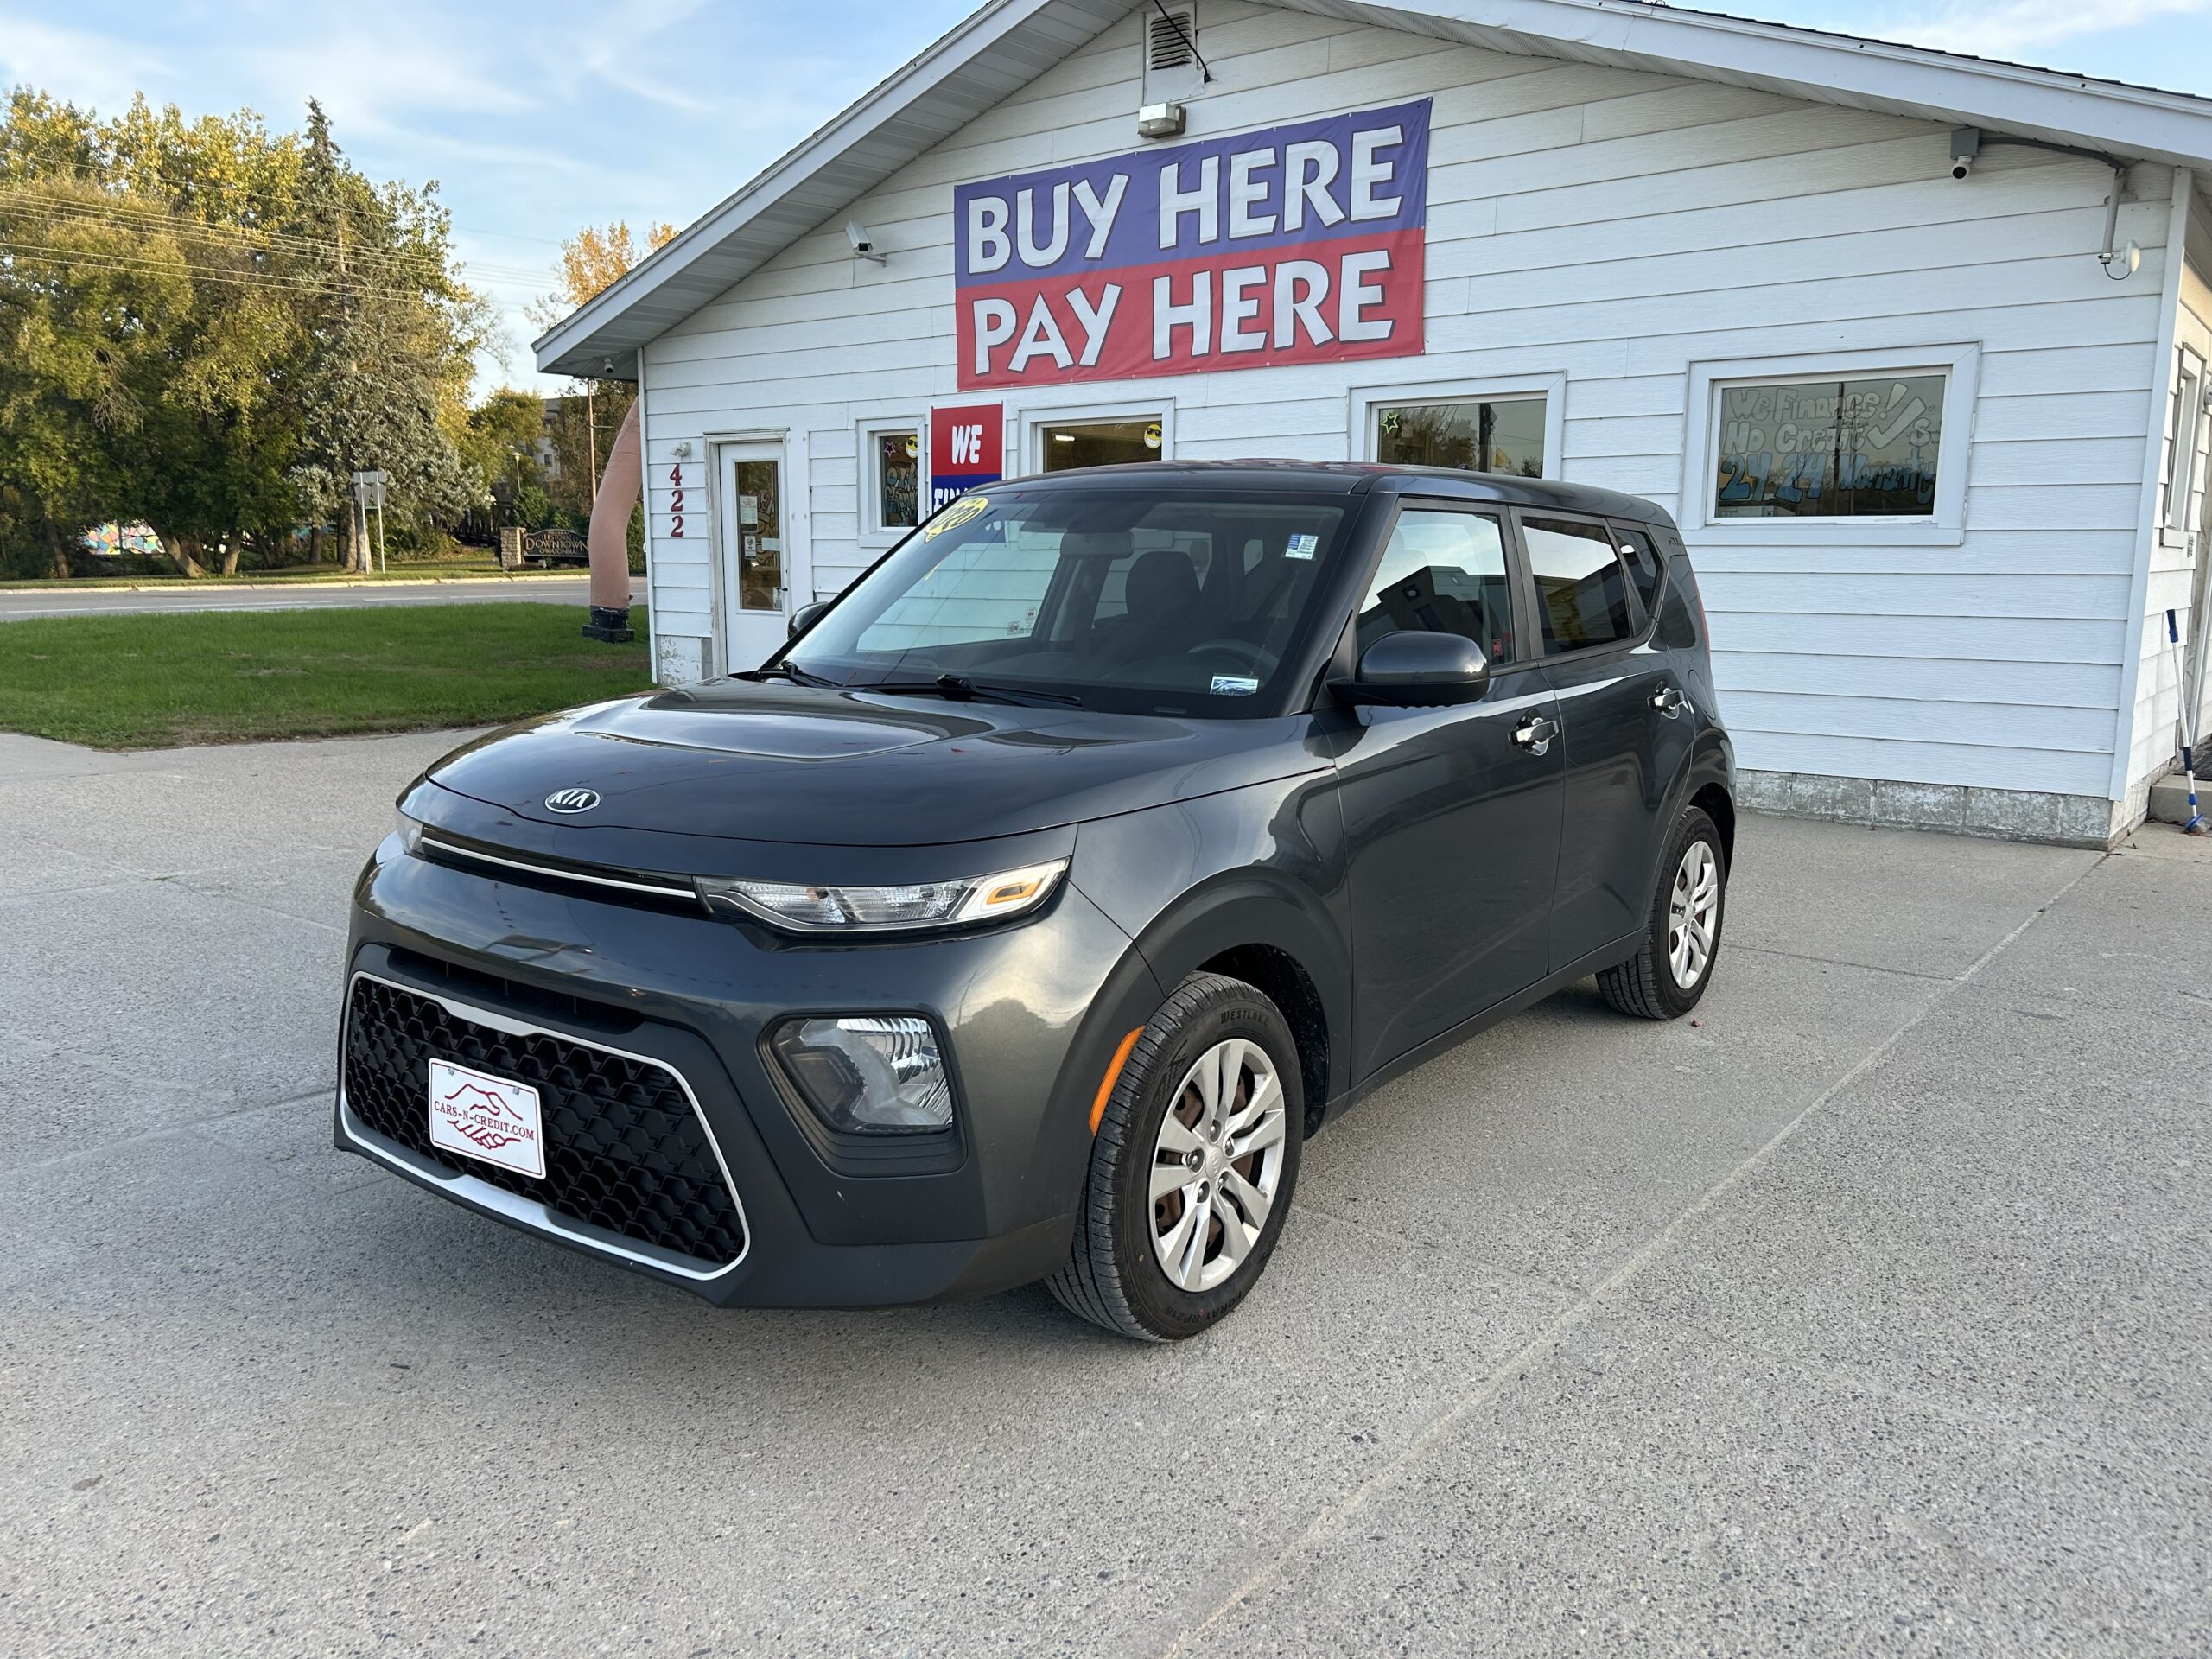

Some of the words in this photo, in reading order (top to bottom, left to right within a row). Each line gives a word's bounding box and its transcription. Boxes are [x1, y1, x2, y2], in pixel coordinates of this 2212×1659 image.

[967, 174, 1129, 275] BUY
[1158, 125, 1404, 251] HERE
[972, 283, 1122, 375] PAY
[1152, 250, 1395, 360] HERE
[1729, 389, 1770, 422] We
[951, 424, 983, 465] WE
[1723, 421, 1766, 455] No
[669, 462, 683, 537] 422
[525, 537, 588, 551] DOWNTOWN
[549, 790, 591, 808] KIA
[1220, 1008, 1268, 1027] WESTLAKE
[434, 1100, 535, 1141] CARS-N-CREDIT.COM
